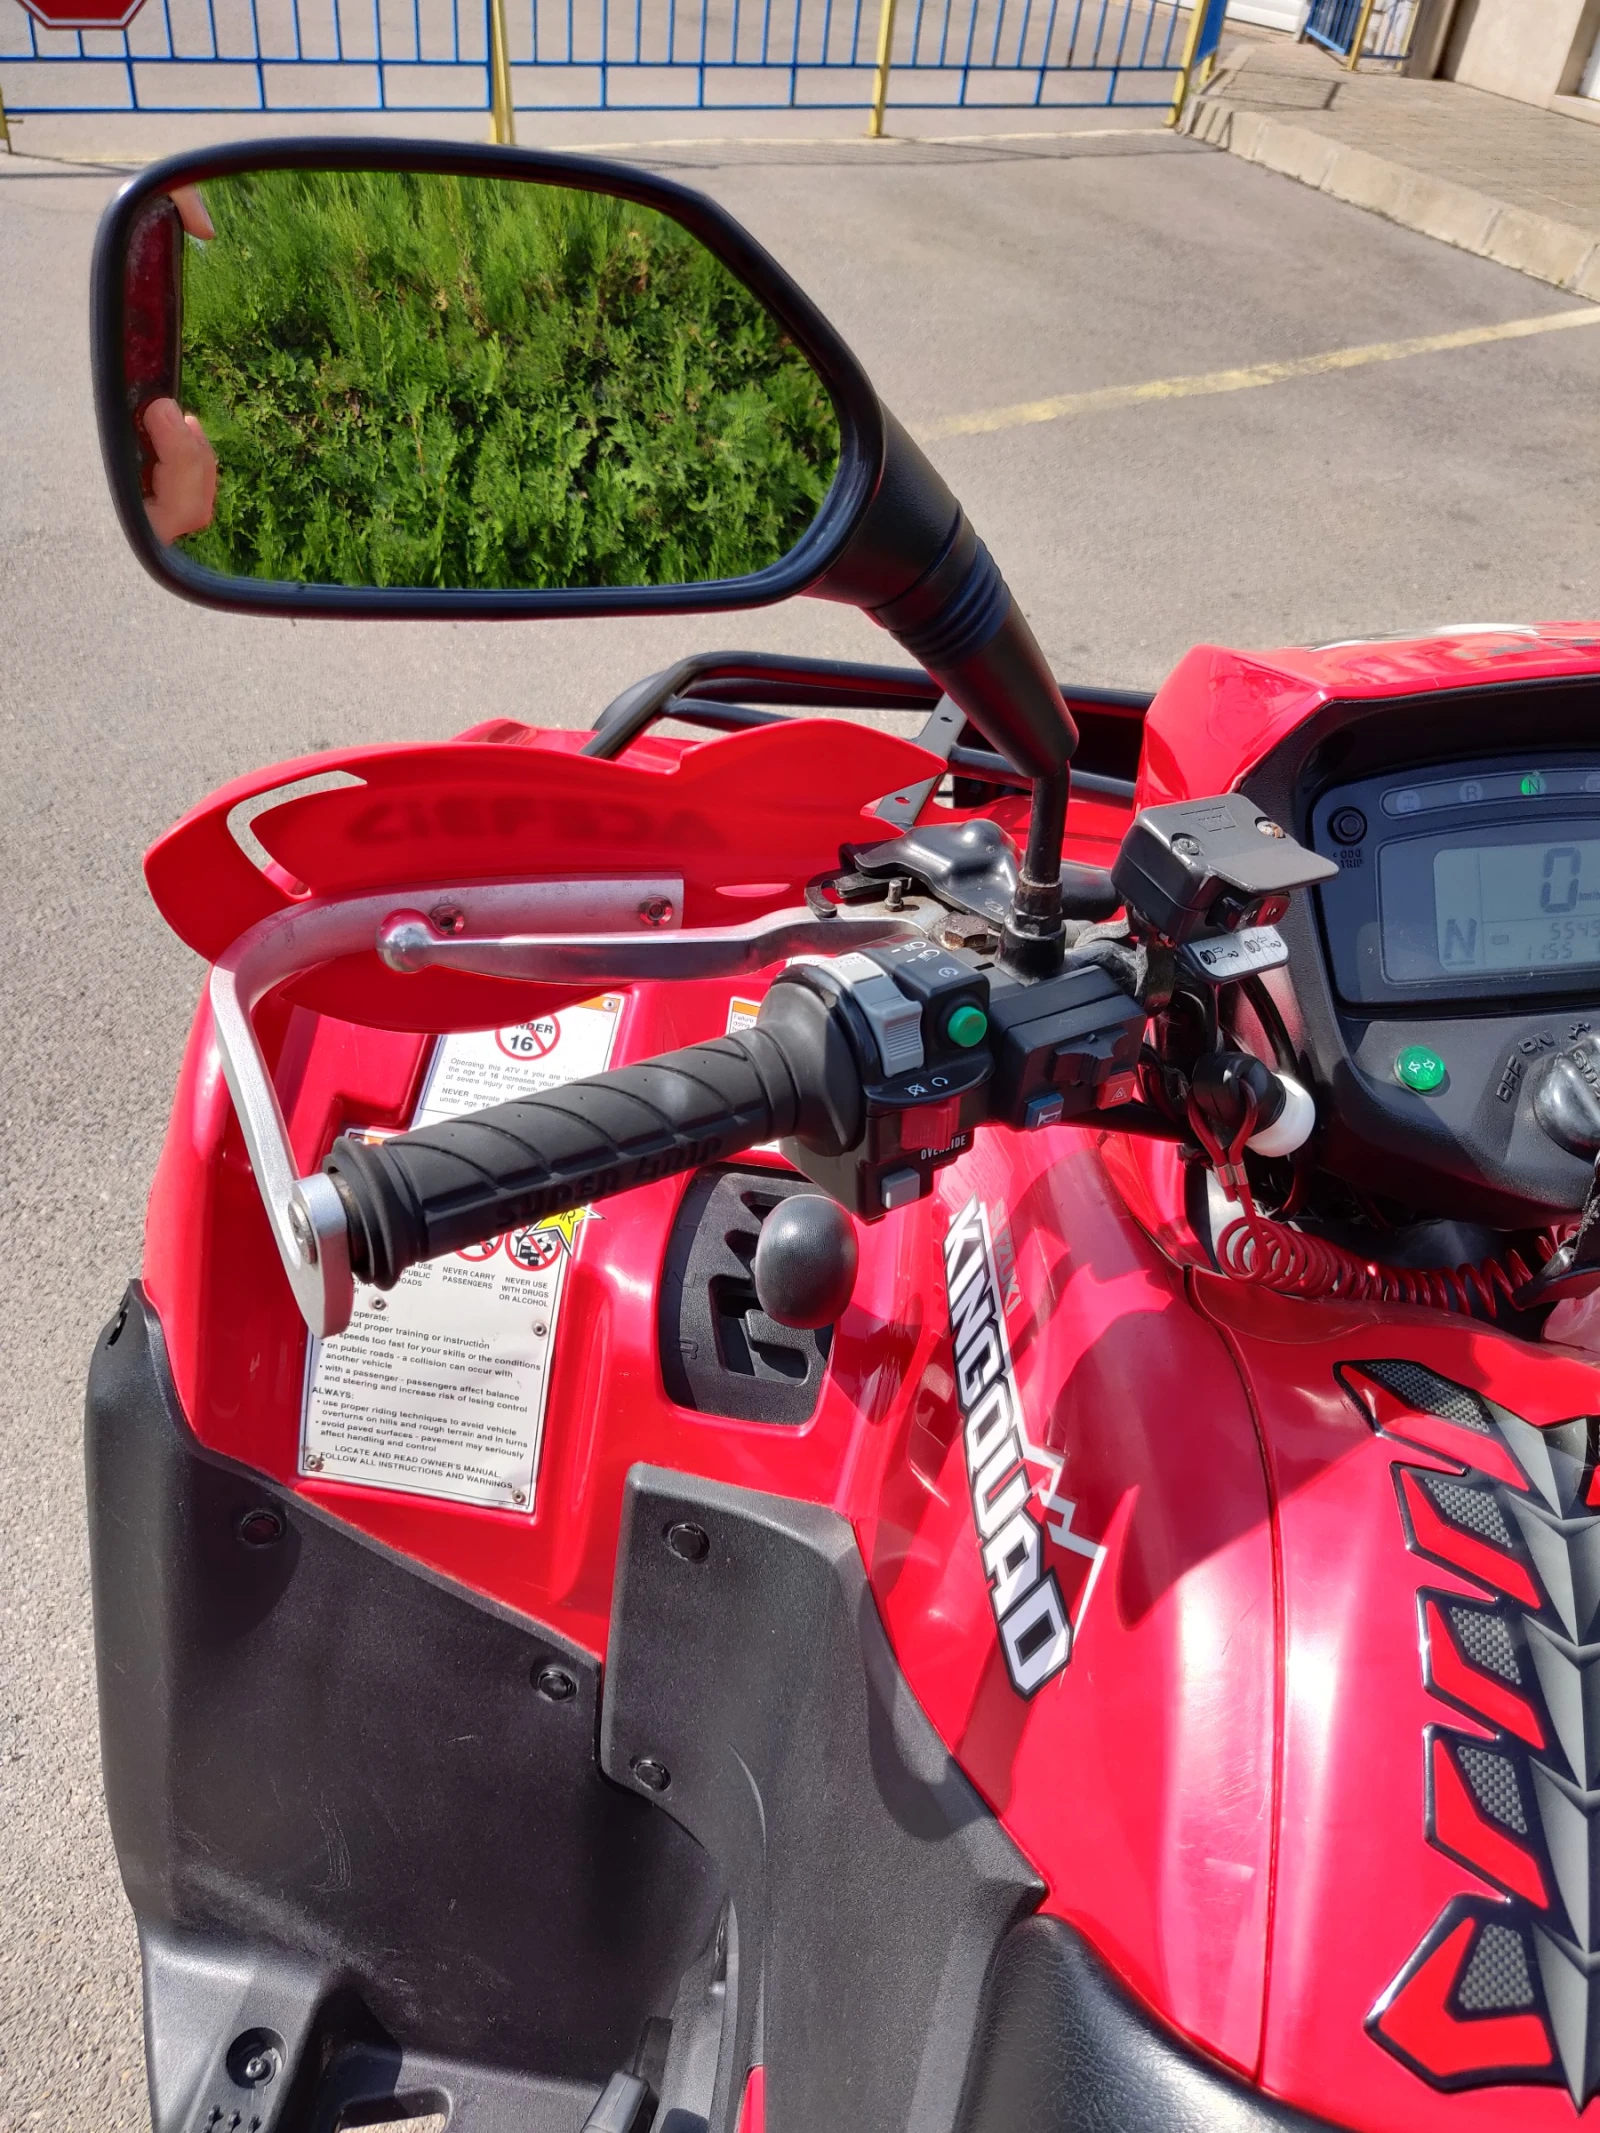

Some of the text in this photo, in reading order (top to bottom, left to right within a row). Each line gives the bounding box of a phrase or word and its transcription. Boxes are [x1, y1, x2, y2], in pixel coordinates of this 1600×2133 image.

[1528, 780, 1541, 793] N
[1540, 847, 1582, 913] 0
[1443, 918, 1478, 960] N
[510, 1034, 535, 1052] 16
[1518, 1029, 1555, 1054] ON
[1496, 1054, 1522, 1101] OFF
[920, 1134, 967, 1160] OVEIDE
[442, 1265, 495, 1281] NEVER CARRY
[442, 1274, 492, 1289] PASSENGERS
[504, 1275, 547, 1289] NEVER USE
[498, 1292, 548, 1307] OR ALCOHOL
[500, 1284, 549, 1298] WITH DRUGS
[363, 1322, 393, 1335] proper
[395, 1326, 429, 1341] training
[443, 1334, 490, 1350] instruction
[325, 1351, 392, 1369] another vehicle
[340, 1343, 367, 1356] public
[369, 1348, 394, 1359] roads
[409, 1355, 447, 1368] collision
[449, 1363, 465, 1371] can
[467, 1365, 492, 1375] occur
[494, 1368, 513, 1378] with
[371, 1336, 386, 1345] too
[387, 1338, 404, 1348] fast
[406, 1341, 419, 1350] for
[420, 1345, 441, 1356] your
[442, 1347, 466, 1358] skills
[478, 1354, 492, 1363] the
[494, 1355, 541, 1370] conditions
[311, 1385, 353, 1399] ALWAYS:
[323, 1373, 527, 1413] and steering and increase risk of losing control
[324, 1363, 343, 1373] with
[352, 1369, 398, 1383] passenger
[406, 1377, 457, 1393] passengers
[459, 1384, 483, 1395] affect
[485, 1388, 520, 1401] balance
[321, 1408, 363, 1421] overturns
[379, 1417, 398, 1426] hills
[399, 1419, 416, 1429] and
[418, 1422, 445, 1434] rough
[446, 1427, 474, 1437] terrain
[476, 1432, 493, 1441] and
[494, 1435, 503, 1443] in
[504, 1437, 528, 1448] turns
[322, 1399, 338, 1407] use
[340, 1402, 369, 1413] proper
[371, 1405, 397, 1418] riding
[399, 1409, 447, 1425] techniques
[460, 1419, 484, 1429] avoid
[485, 1423, 517, 1436] vehicle
[320, 1418, 344, 1429] avoid
[346, 1422, 373, 1434] paved
[375, 1426, 413, 1439] surfaces
[420, 1434, 463, 1448] pavement
[465, 1442, 482, 1452] may
[484, 1445, 524, 1460] seriously
[320, 1428, 436, 1452] affect handling and control
[943, 1191, 1073, 1701] KINGQUAD
[334, 1444, 370, 1456] LOCATE
[372, 1450, 391, 1459] AND
[393, 1453, 418, 1463] READ
[420, 1457, 461, 1470] OWNER'S
[359, 1457, 375, 1466] ALL
[378, 1459, 443, 1477] INSTRUCTIONS
[445, 1470, 464, 1480] AND
